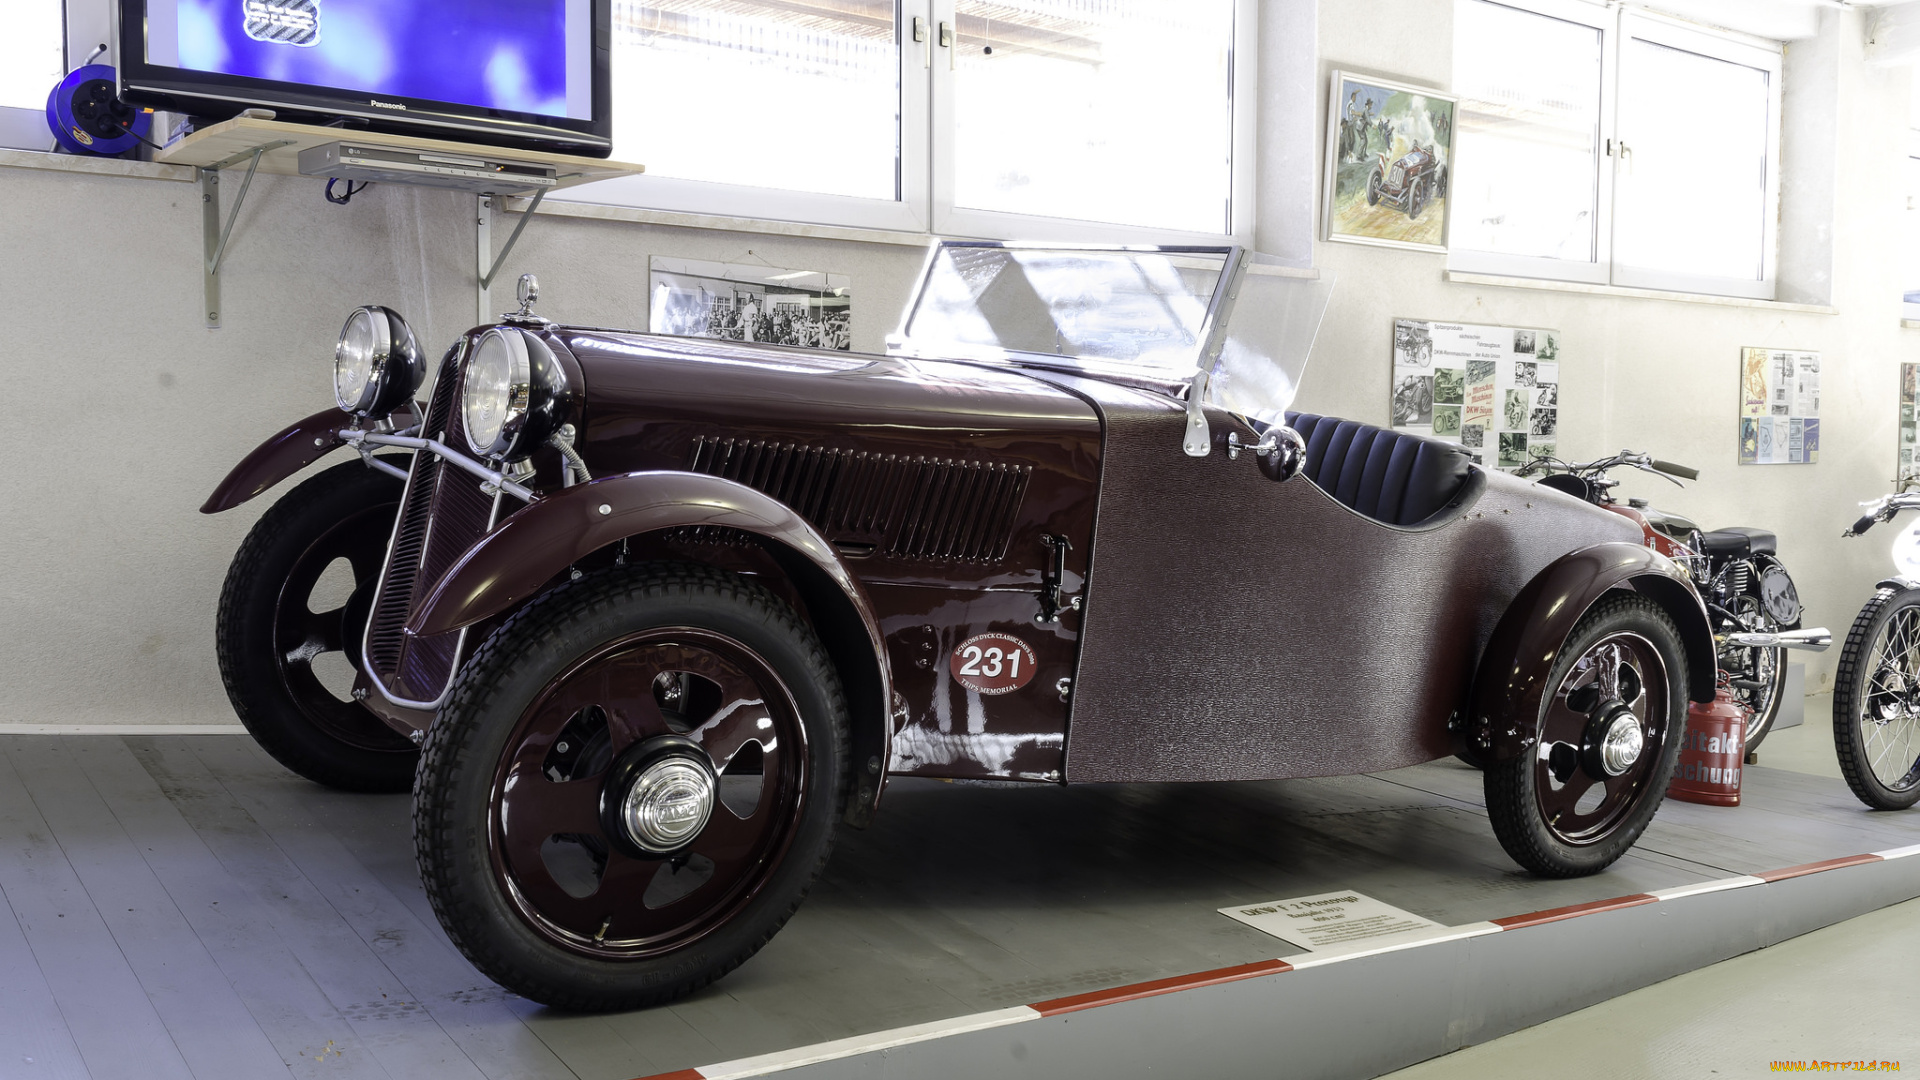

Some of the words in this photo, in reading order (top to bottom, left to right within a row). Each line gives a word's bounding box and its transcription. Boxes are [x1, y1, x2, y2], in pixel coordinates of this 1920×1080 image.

[370, 99, 407, 111] Panasonic
[1466, 405, 1479, 414] DKW
[955, 635, 980, 656] SCHLOSS
[996, 633, 1019, 644] CLASSIC
[1017, 640, 1031, 653] DAYS
[959, 645, 1021, 679] 231
[960, 677, 980, 692] TRIPS
[980, 683, 1018, 695] MEMORIAL
[1682, 729, 1743, 754] eitakt-
[1674, 760, 1741, 790] schung
[1239, 904, 1278, 916] DKW
[1277, 904, 1290, 912] F
[1300, 895, 1359, 908] Prototyp
